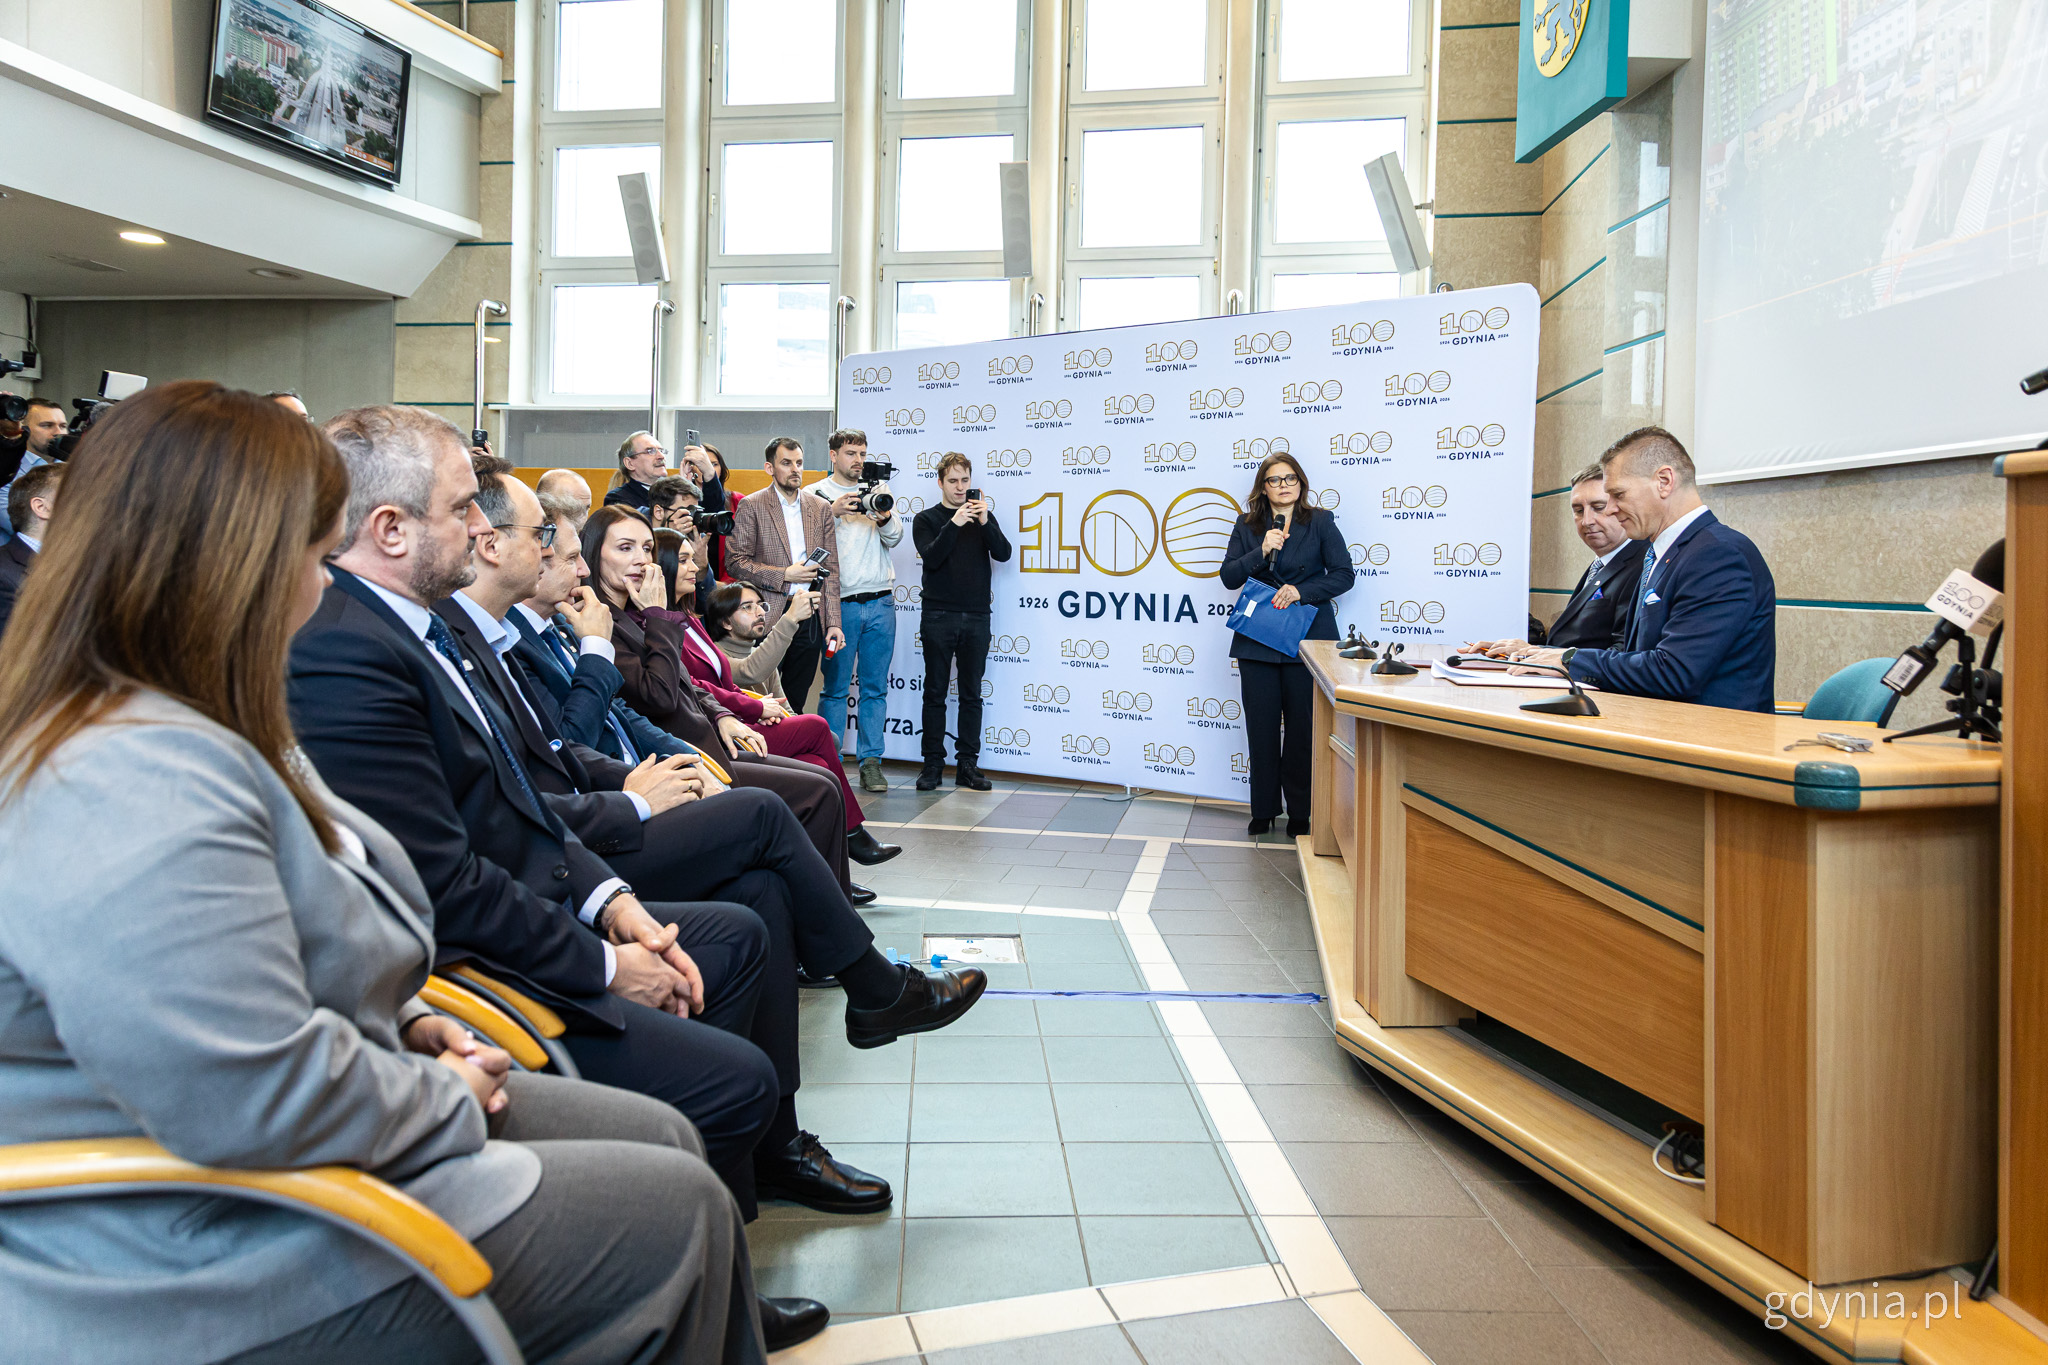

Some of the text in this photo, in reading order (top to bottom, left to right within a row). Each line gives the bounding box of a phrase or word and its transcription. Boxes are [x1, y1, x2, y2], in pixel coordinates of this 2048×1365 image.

[1440, 307, 1509, 335] 100
[1235, 331, 1291, 355] 100
[1332, 320, 1395, 346] 100
[1452, 334, 1495, 345] GDYNIA
[1064, 347, 1112, 370] 100
[1146, 340, 1198, 363] 100
[1245, 355, 1280, 365] GDYNIA
[1343, 346, 1382, 356] GDYNIA
[853, 366, 892, 385] 100
[918, 361, 960, 382] 100
[988, 355, 1033, 376] 100
[1073, 370, 1102, 379] GDYNIA
[1155, 363, 1187, 372] GDYNIA
[996, 377, 1024, 385] GDYNIA
[1385, 371, 1450, 397] 100
[1190, 387, 1244, 410] 100
[1283, 380, 1342, 404] 100
[1397, 397, 1437, 407] GDYNIA
[953, 404, 996, 424] 100
[1026, 400, 1072, 420] 100
[1104, 394, 1154, 416] 100
[1293, 405, 1330, 414] GDYNIA
[885, 408, 925, 427] 100
[1034, 421, 1063, 429] GDYNIA
[1114, 417, 1144, 425] GDYNIA
[1200, 411, 1233, 420] GDYNIA
[1330, 431, 1392, 455] 100
[1437, 424, 1505, 450] 100
[917, 452, 943, 469] 10
[987, 448, 1031, 468] 100
[1062, 445, 1110, 466] 100
[1144, 441, 1196, 463] 100
[1341, 457, 1380, 466] GDYNIA
[1449, 451, 1491, 460] GDYNIA
[896, 497, 924, 514] 00
[1383, 485, 1447, 509] 100
[1394, 512, 1434, 520] GDYNIA
[1019, 488, 1243, 577] 100
[1347, 544, 1390, 565] 00
[1434, 542, 1501, 566] 100
[1446, 569, 1488, 577] GDYNIA
[894, 585, 922, 603] 00
[895, 604, 915, 612] DYNIA
[1019, 590, 1234, 623] 1926 GDYNIA 202
[1381, 600, 1444, 624] 100
[1937, 594, 1973, 618] GDYNIA
[1392, 626, 1432, 635] GDYNIA
[993, 655, 1021, 663] GDYNIA
[1062, 639, 1108, 659] 100
[1142, 644, 1195, 665] 100
[1070, 660, 1100, 669] GDYNIA
[1152, 666, 1185, 675] GDYNIA
[909, 675, 922, 692] si
[1024, 684, 1070, 704] 100
[1103, 690, 1152, 712] 100
[1032, 704, 1062, 714] GDYNIA
[1111, 712, 1143, 721] GDYNIA
[1187, 697, 1241, 720] 100
[1197, 720, 1231, 730] GDYNIA
[986, 726, 1030, 748] 100
[1062, 734, 1110, 756] 100
[994, 747, 1022, 756] GDYNIA
[1071, 755, 1101, 765] GDYNIA
[1144, 742, 1195, 767] 100
[1153, 765, 1186, 775] GDYNIA
